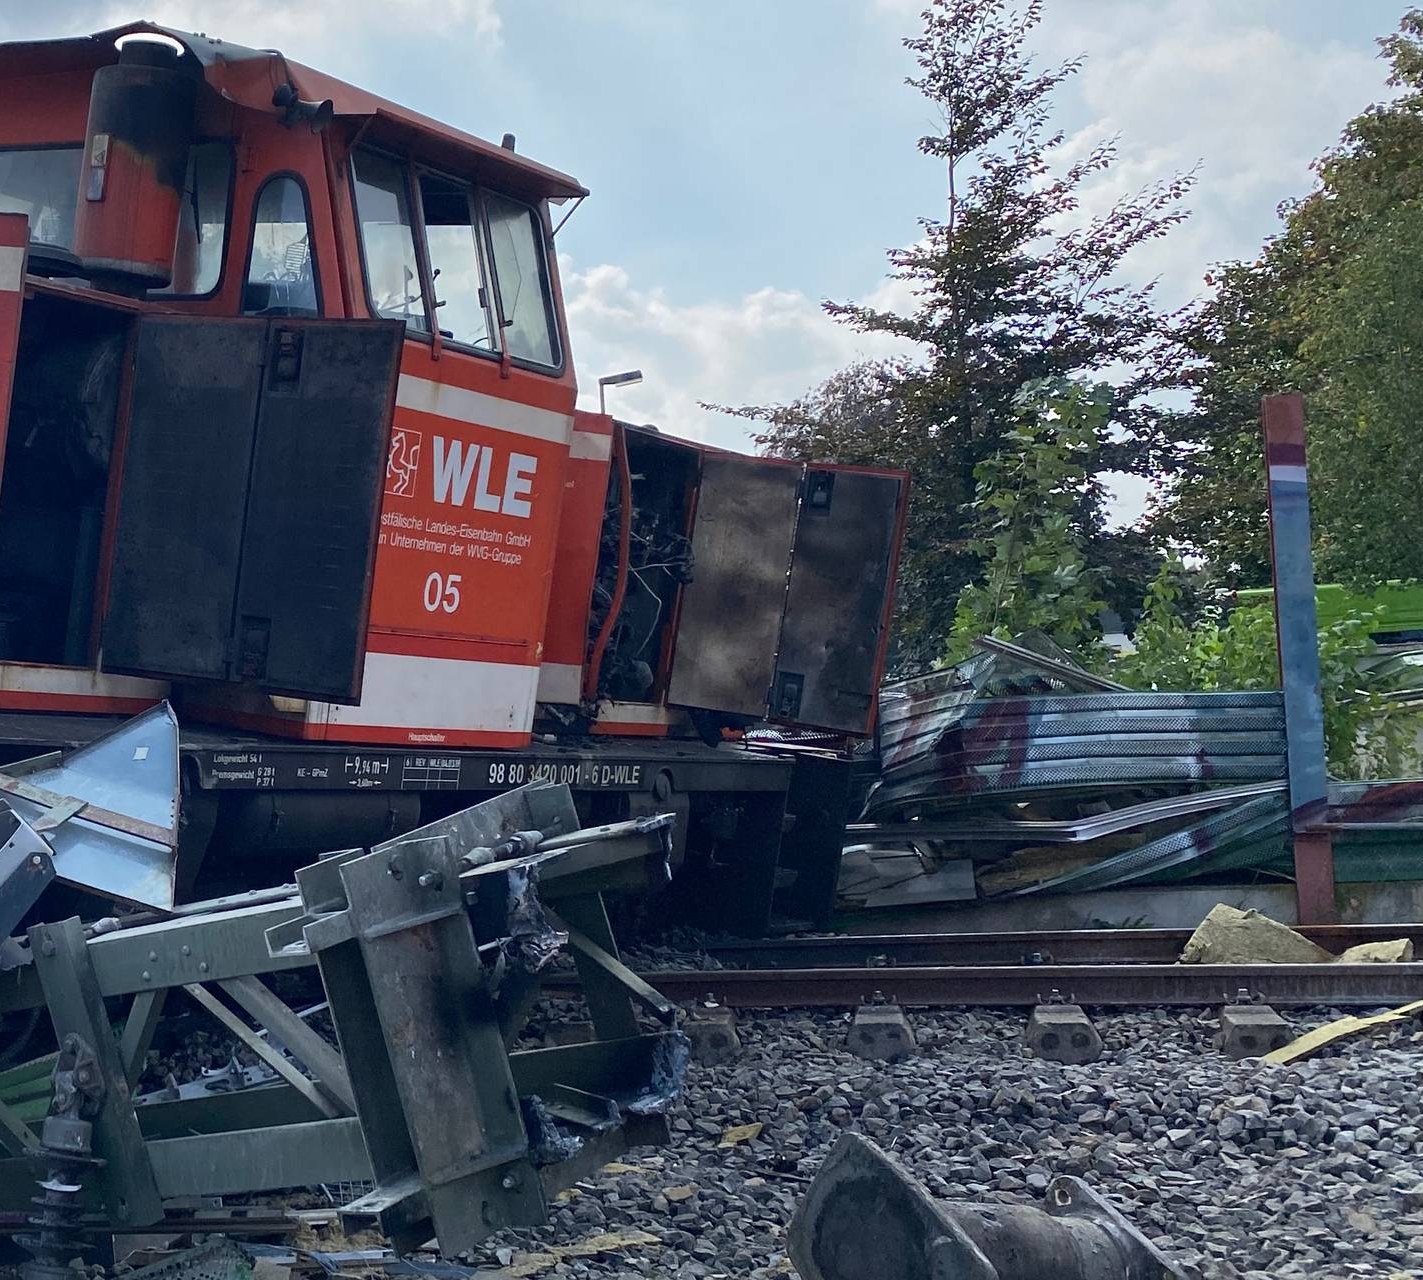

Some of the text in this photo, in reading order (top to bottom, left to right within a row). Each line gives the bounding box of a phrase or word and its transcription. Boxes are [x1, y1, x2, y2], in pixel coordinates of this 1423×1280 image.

[433, 435, 538, 518] WLE
[378, 530, 522, 565] in Unternehmen der WVG-Gruppe
[425, 518, 503, 543] Landes-Eisenbahn
[505, 531, 532, 547] GmbH
[423, 571, 462, 613] 05
[213, 753, 248, 765] Lokgewicht
[488, 763, 505, 784] 98
[508, 764, 525, 784] 80
[560, 764, 581, 784] 001
[591, 765, 600, 784] 6
[601, 765, 641, 787] D-WLE
